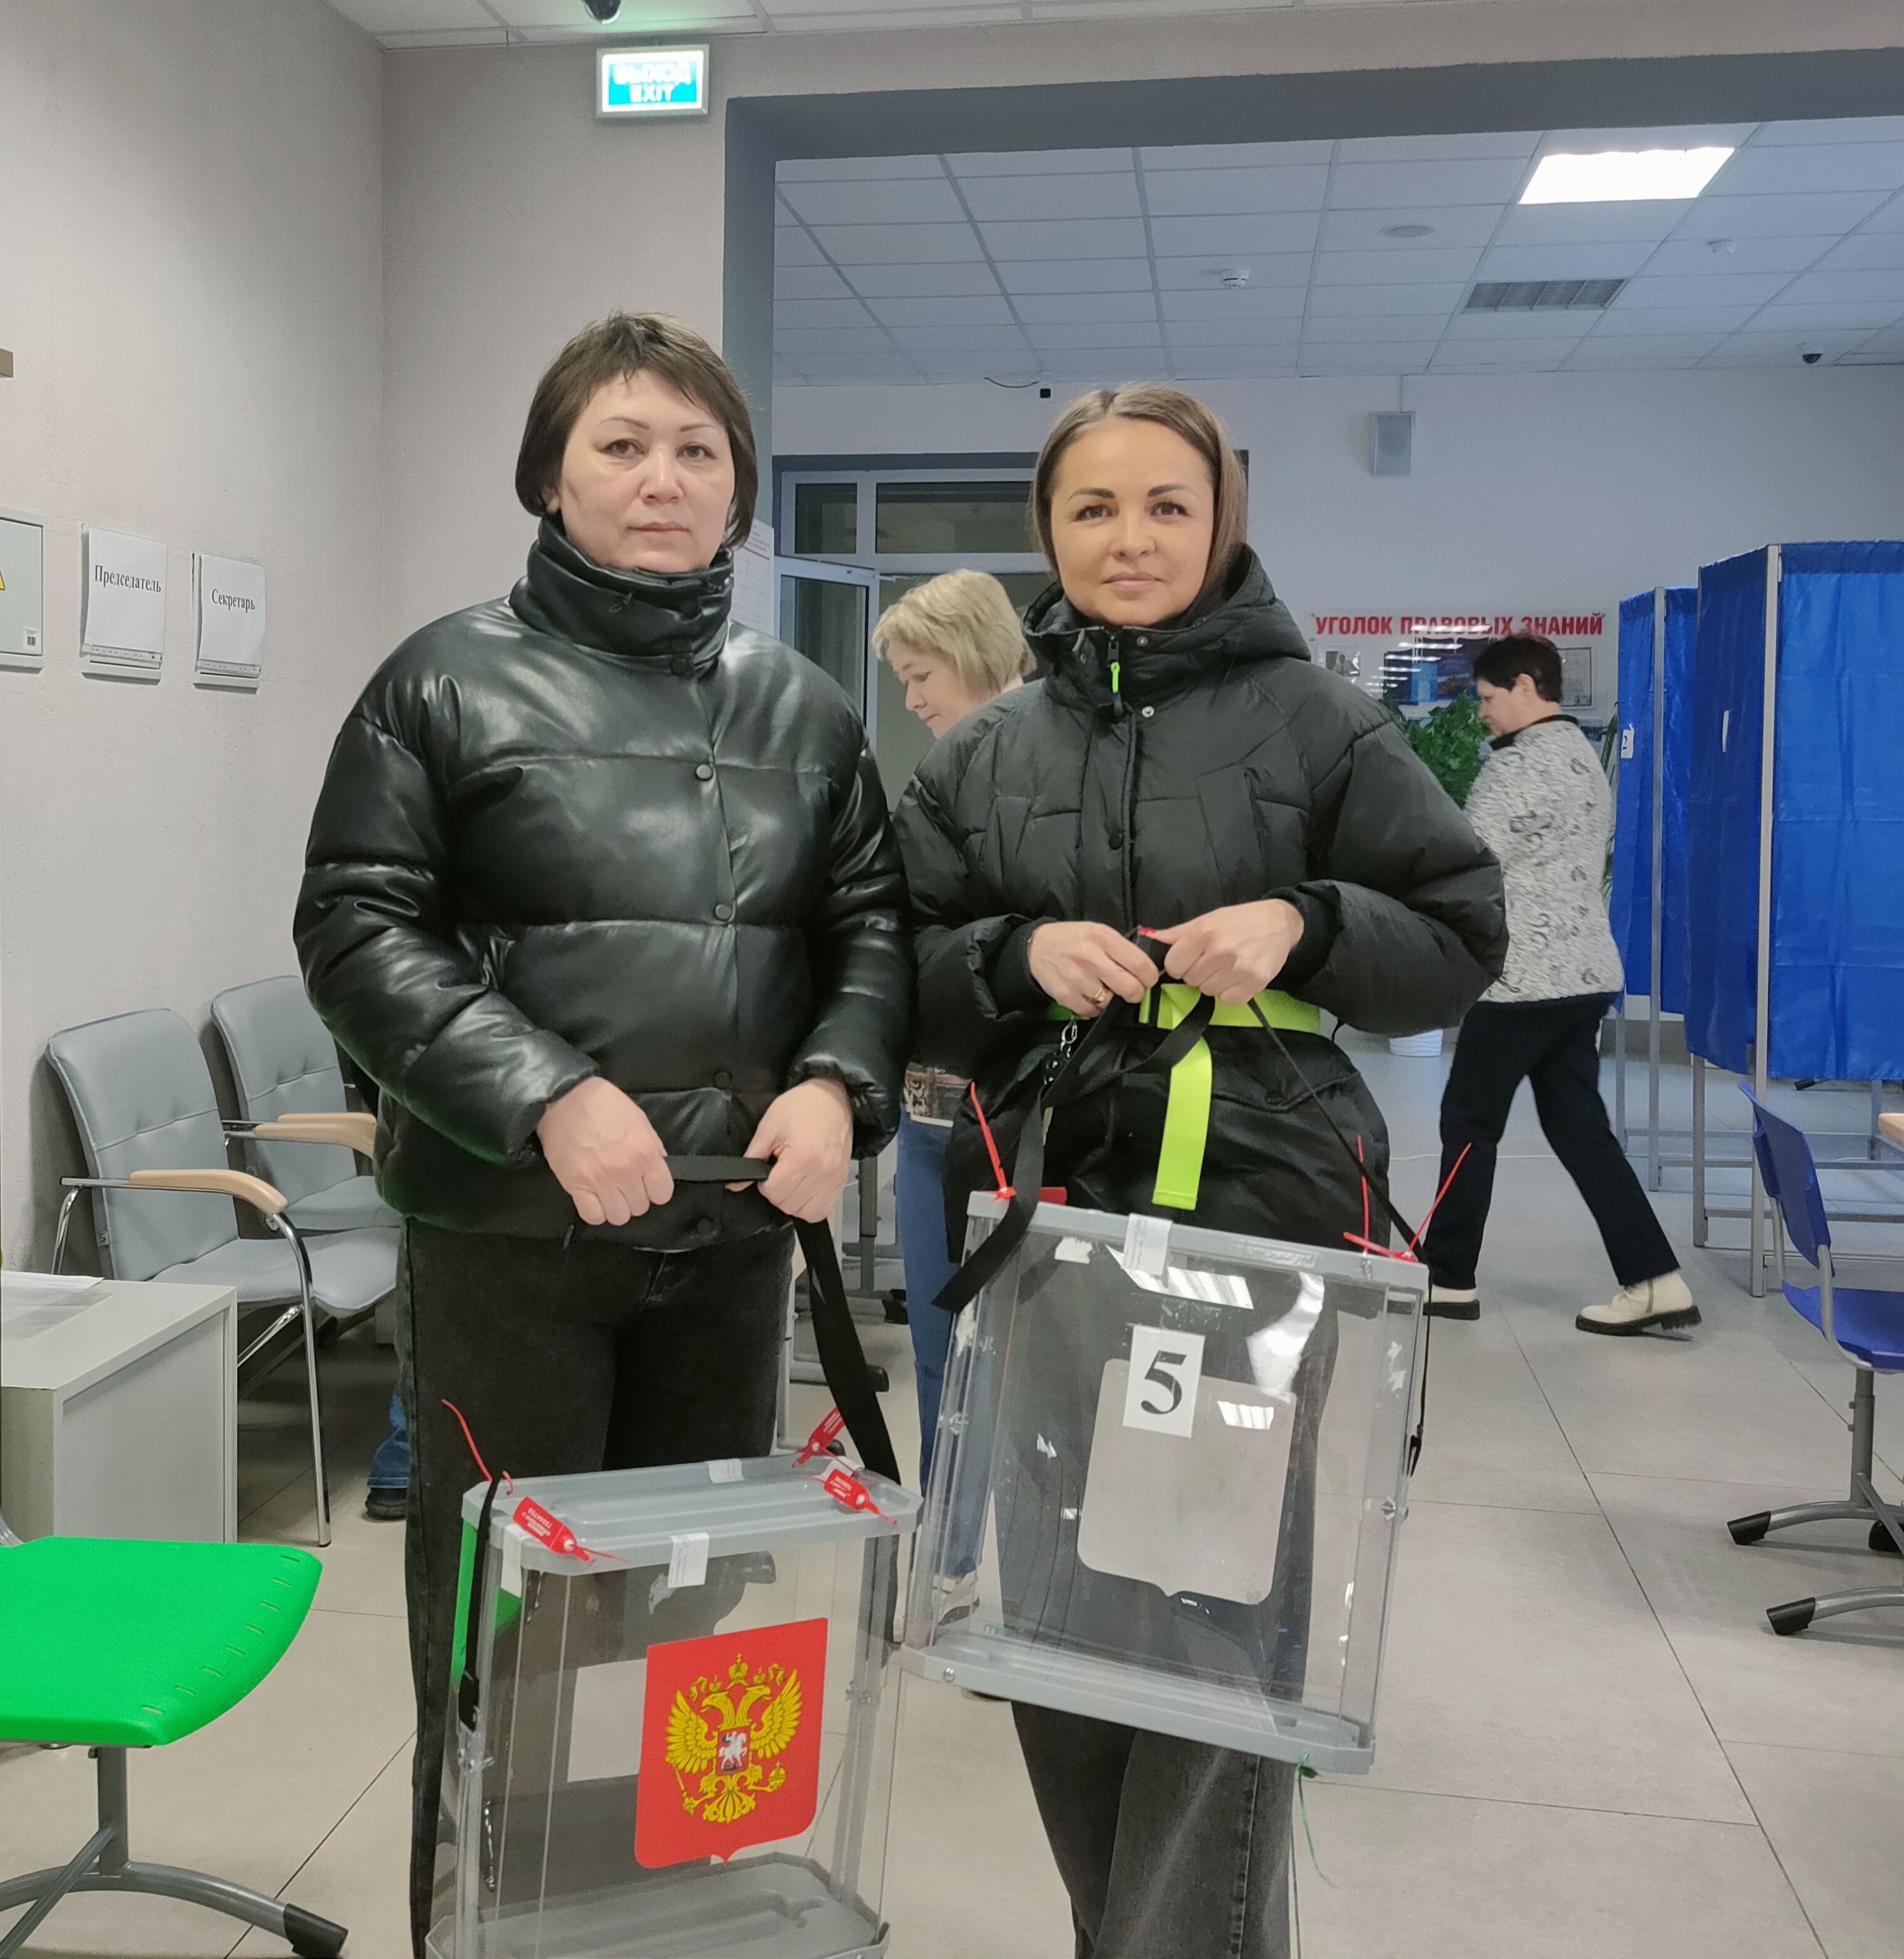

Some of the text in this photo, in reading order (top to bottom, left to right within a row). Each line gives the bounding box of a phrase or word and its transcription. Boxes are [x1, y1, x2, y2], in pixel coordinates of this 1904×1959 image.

[94, 564, 162, 593] Председатель
[211, 589, 255, 613] Секретарь
[1315, 612, 1602, 635] УГОЛОК ПРАВОВЫХ ЗНАНИЙ
[1623, 735, 1628, 750] 2
[1141, 1350, 1187, 1415] 5
